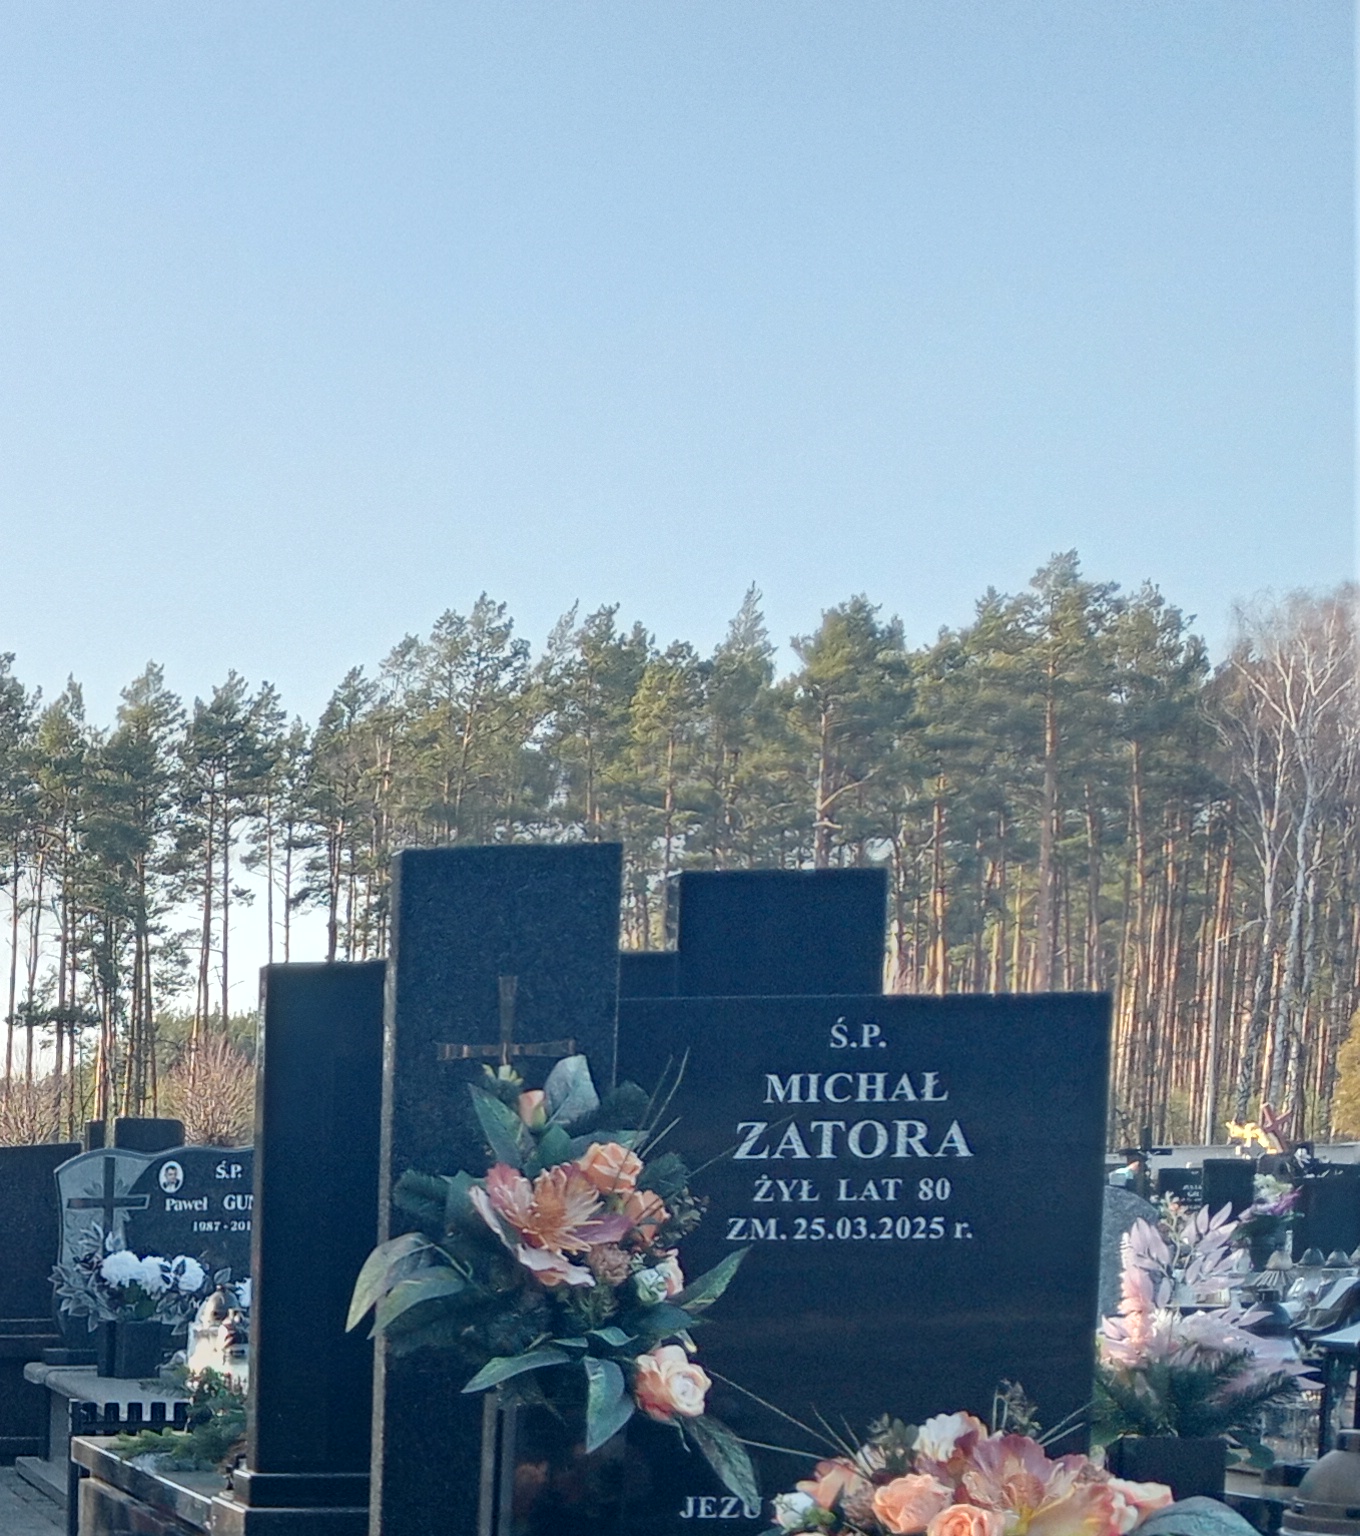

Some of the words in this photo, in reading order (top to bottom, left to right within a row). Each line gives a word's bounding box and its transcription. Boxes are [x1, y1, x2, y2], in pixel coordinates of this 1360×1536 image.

[829, 1016, 887, 1048] Ś.P.
[763, 1071, 949, 1103] MICHAŁ
[732, 1119, 974, 1160] ZATORA
[215, 1160, 242, 1179] Ś.P.
[753, 1174, 820, 1202] ŻYŁ
[837, 1178, 903, 1202] LAT
[918, 1177, 951, 1201] 80
[726, 1217, 787, 1240] ZM.
[793, 1216, 945, 1240] 25.03.2025
[954, 1221, 973, 1239] r.
